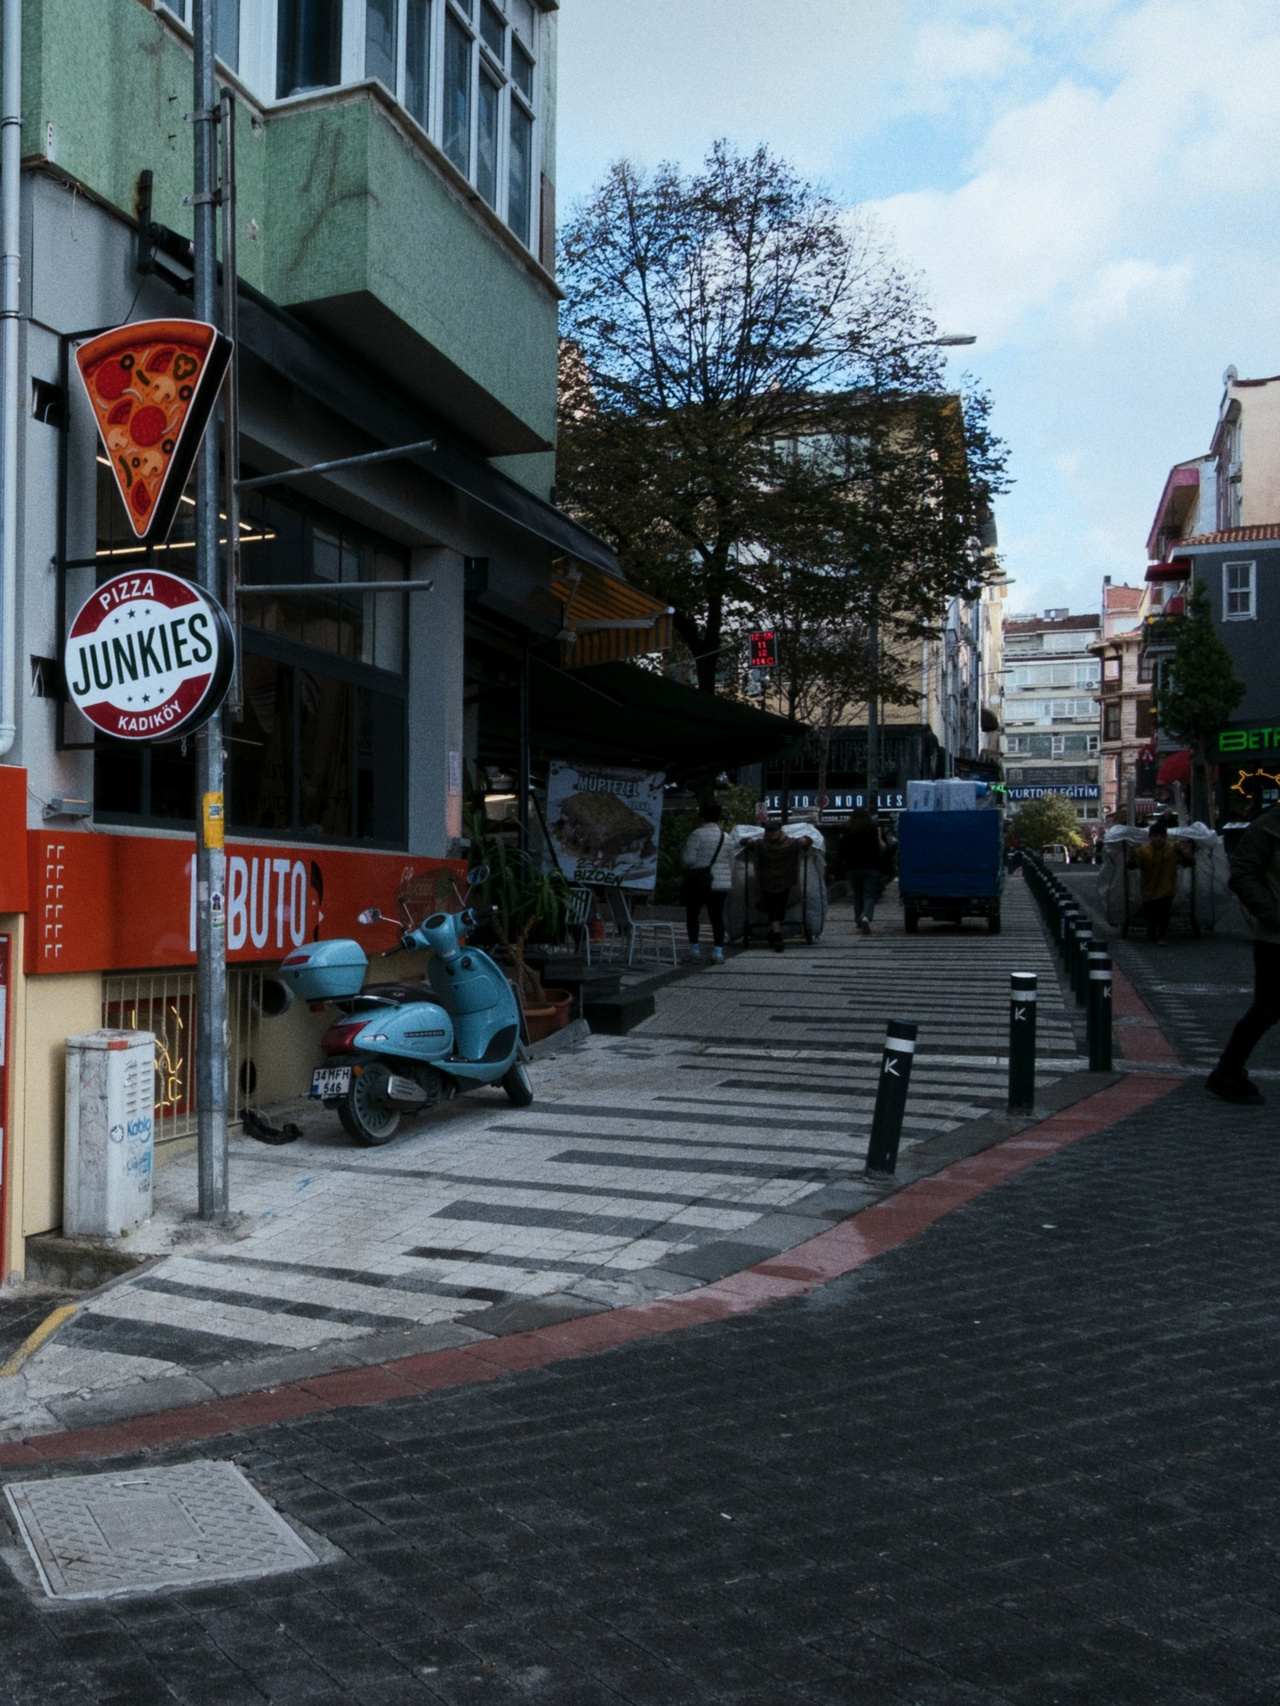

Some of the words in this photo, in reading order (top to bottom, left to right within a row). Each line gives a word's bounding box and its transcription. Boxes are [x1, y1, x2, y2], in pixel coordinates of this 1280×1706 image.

[99, 579, 154, 611] PIZZA
[72, 613, 213, 696] JUNKIES
[117, 700, 182, 732] KADIKÖY
[578, 774, 639, 797] MÜPTEZEL
[765, 795, 808, 808] BETO
[835, 794, 903, 808] NOOLES
[189, 854, 308, 952] IBUTO
[315, 1071, 326, 1081] 34
[328, 1069, 350, 1080] MFH
[323, 1082, 342, 1094] 546
